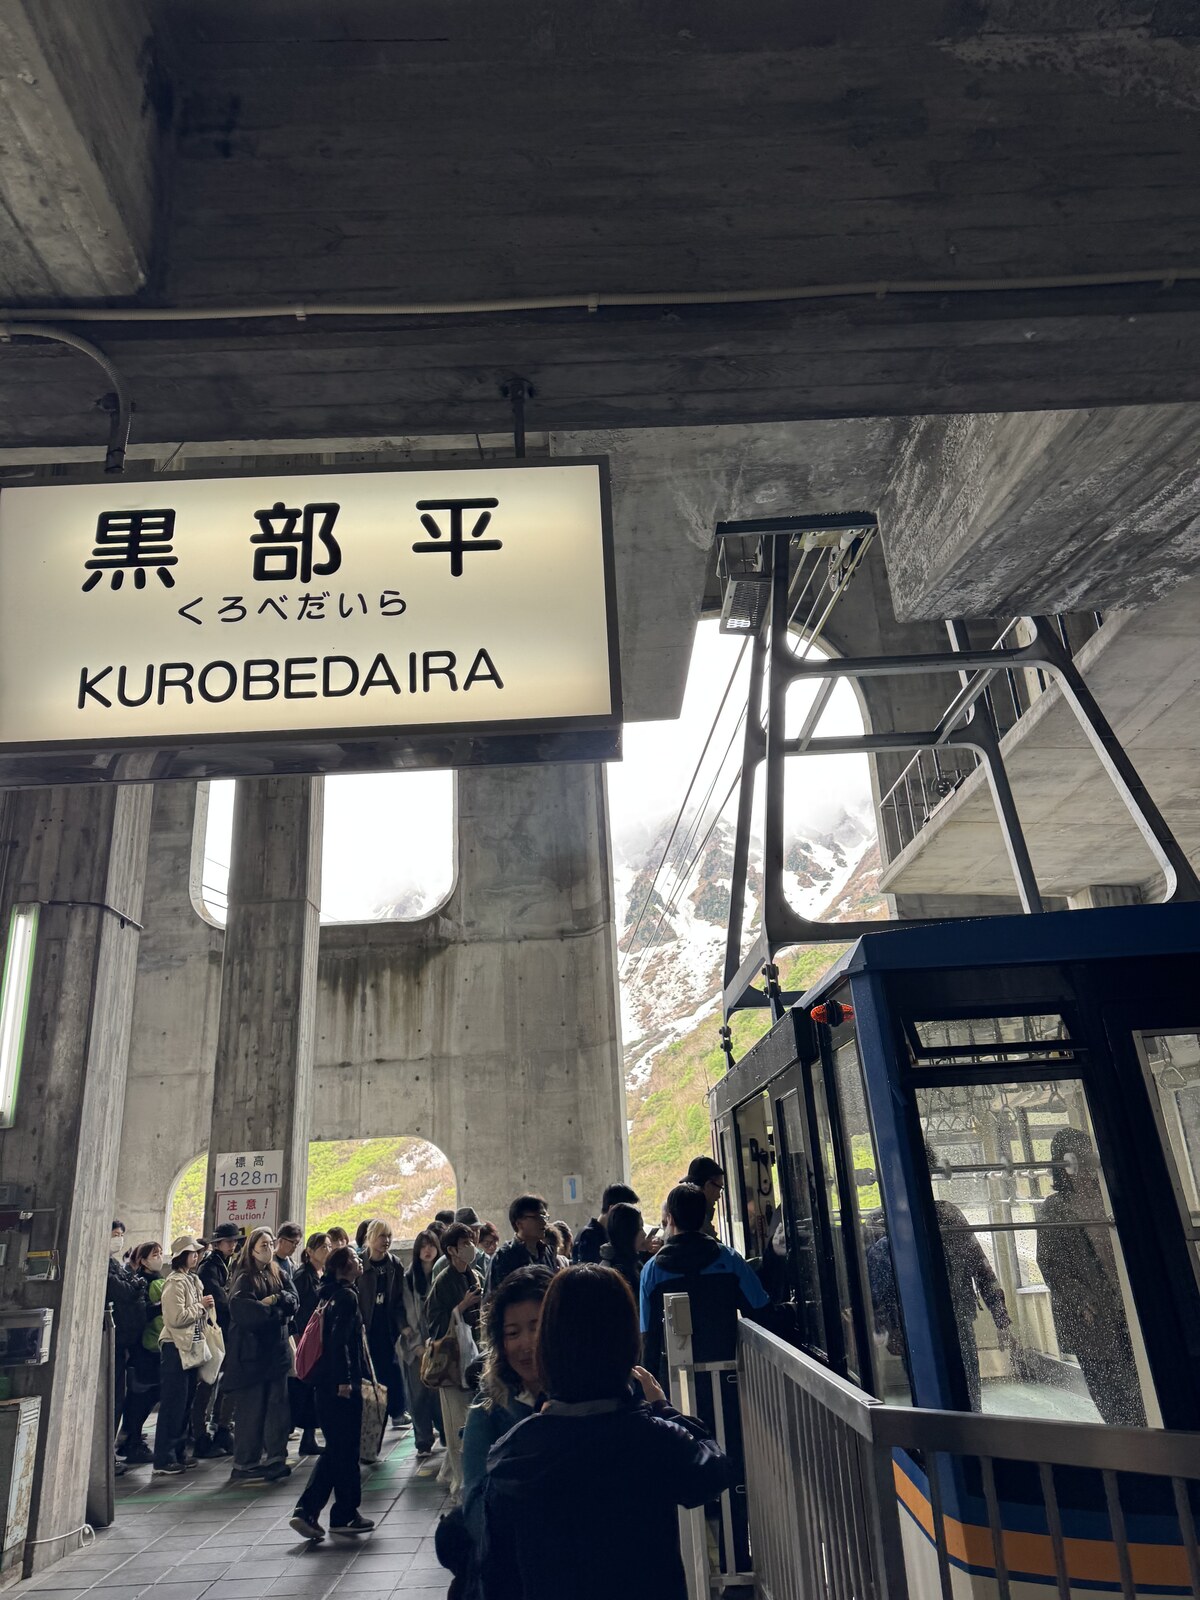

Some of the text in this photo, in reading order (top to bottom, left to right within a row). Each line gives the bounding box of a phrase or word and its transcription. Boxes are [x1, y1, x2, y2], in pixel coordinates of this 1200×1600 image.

[82, 498, 502, 592] 黒部平
[179, 591, 407, 625] くろべだいら
[78, 649, 504, 709] KUROBEDAIRA
[235, 1156, 264, 1168] 標高
[220, 1171, 278, 1187] 1828m
[228, 1211, 266, 1221] Caution!
